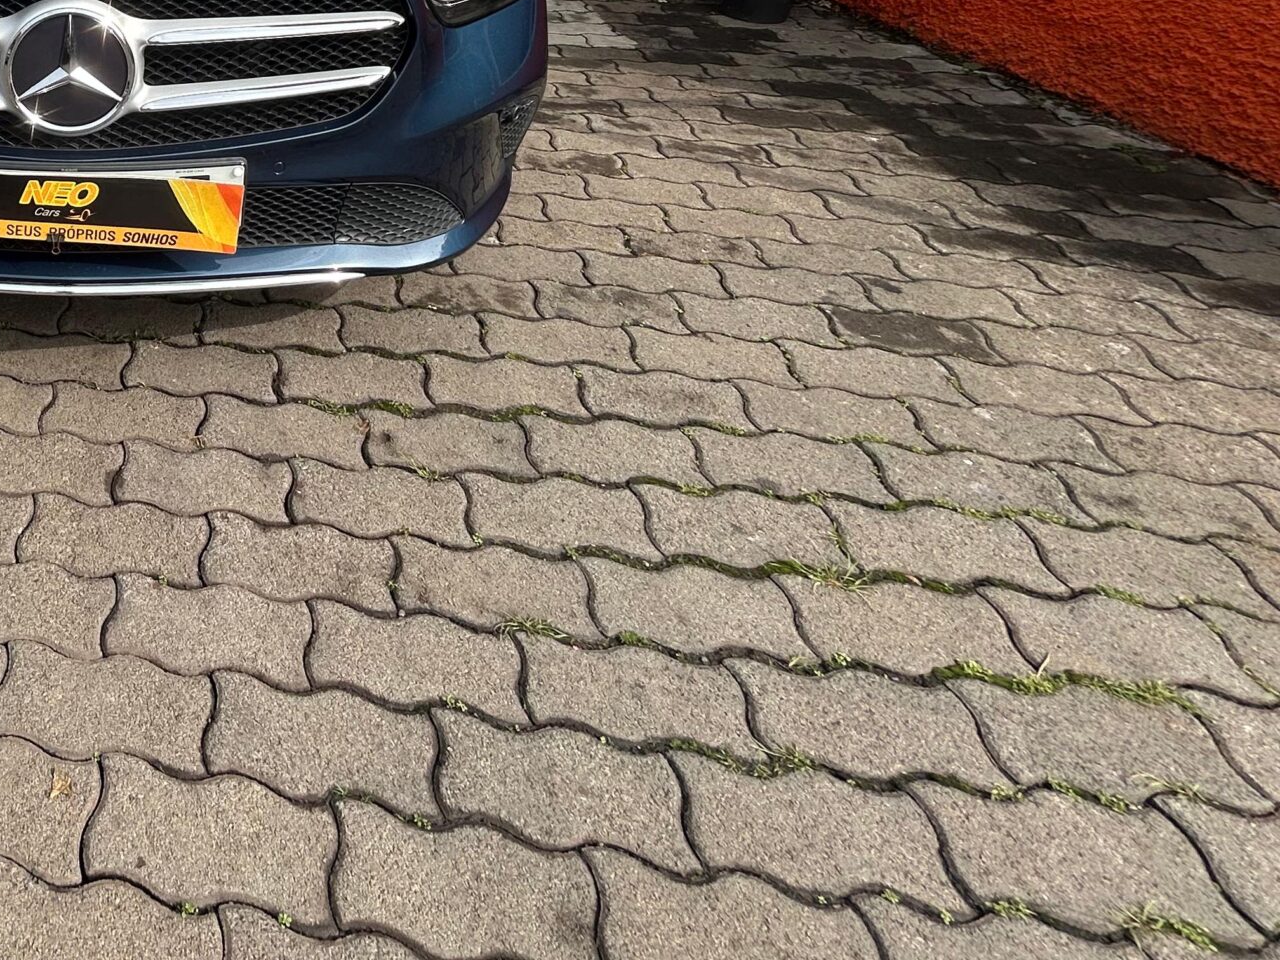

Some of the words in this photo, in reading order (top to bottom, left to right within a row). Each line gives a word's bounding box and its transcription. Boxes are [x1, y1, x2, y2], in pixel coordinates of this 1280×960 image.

[19, 180, 99, 208] NEO
[34, 207, 61, 218] Cars
[6, 224, 42, 238] SEUS
[122, 231, 179, 246] SONHOS
